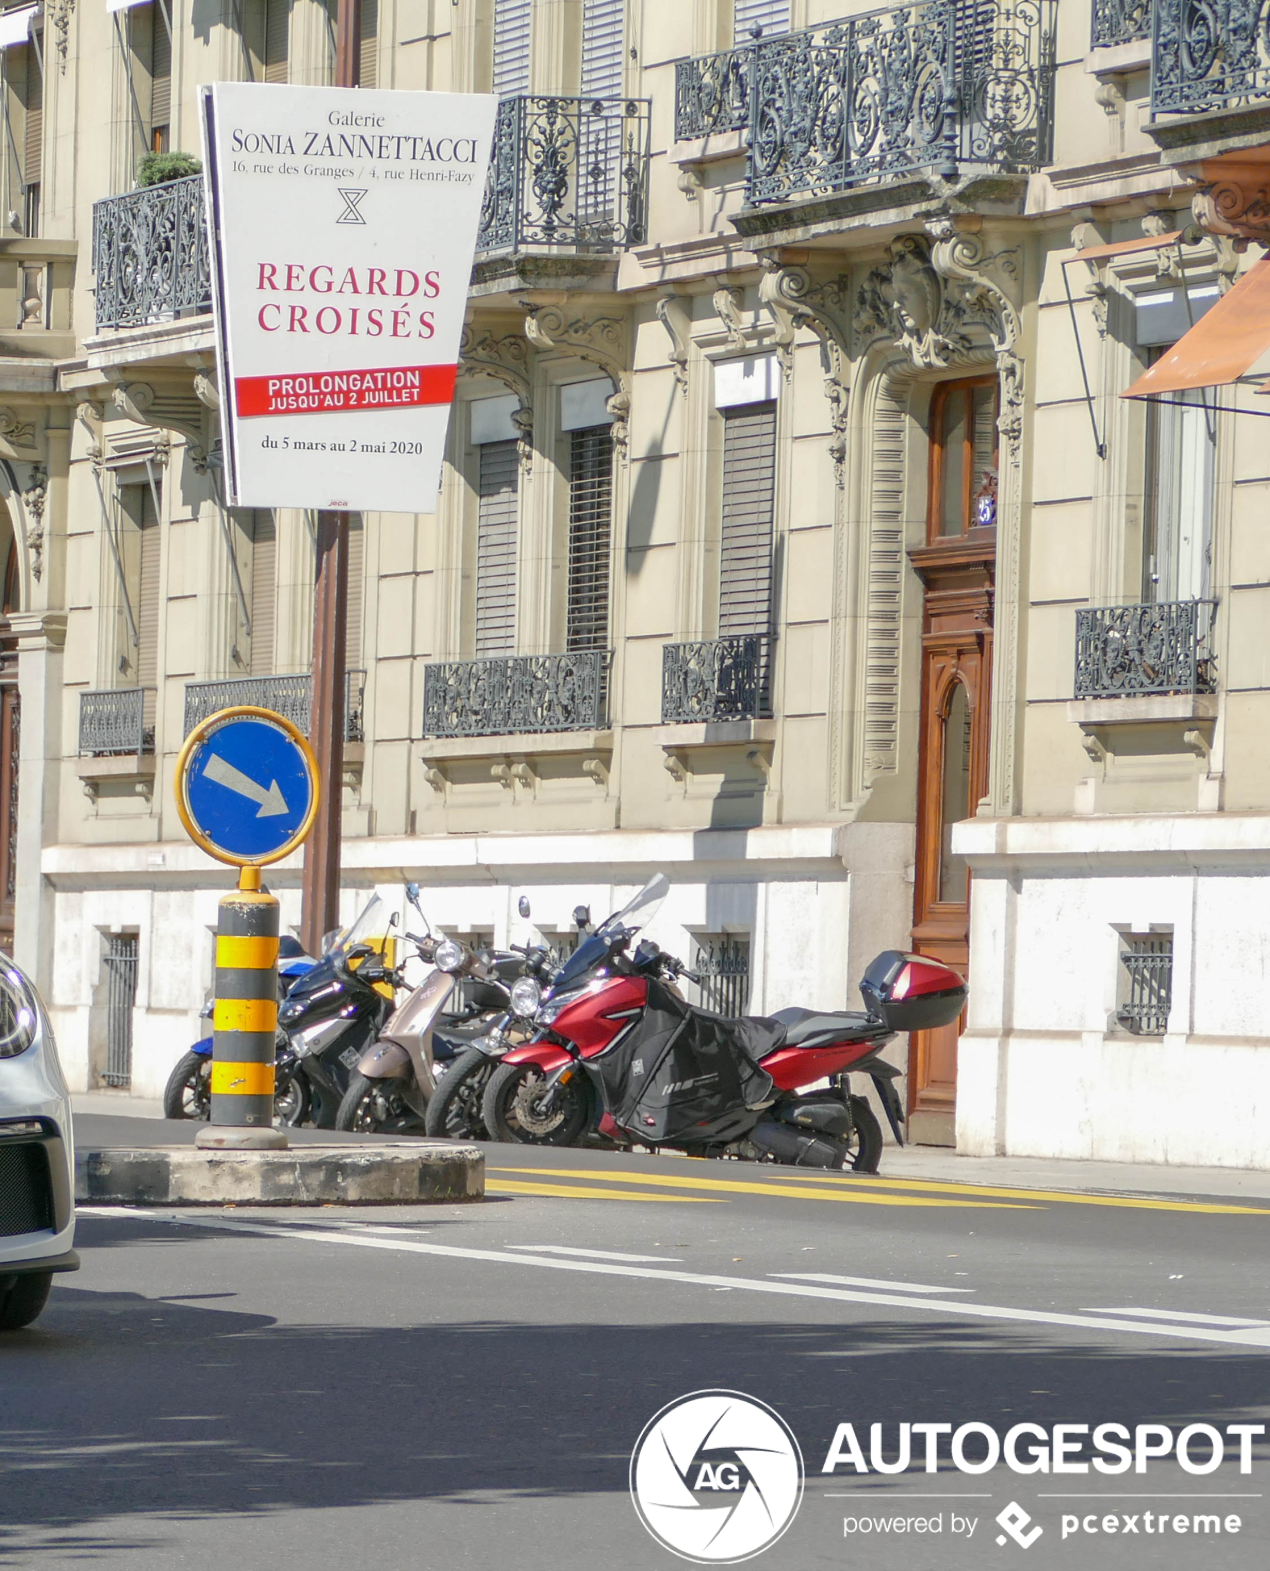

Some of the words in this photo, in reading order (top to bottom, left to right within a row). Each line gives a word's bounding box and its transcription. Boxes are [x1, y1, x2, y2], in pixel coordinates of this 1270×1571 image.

[328, 110, 386, 128] Galerie
[231, 128, 296, 155] SONIA
[303, 131, 479, 164] ZANNETTACCI
[232, 160, 249, 174] 16,
[253, 163, 275, 174] rue
[278, 162, 300, 176] des
[303, 163, 356, 180] Granges
[384, 170, 406, 180] rue
[409, 168, 476, 187] Henri-Fazy
[256, 262, 441, 299] REGARDS
[257, 302, 436, 339] CROISÉS
[267, 369, 421, 397] PROLONGATION
[267, 392, 345, 411] JUSQU'AU
[349, 392, 358, 405] 2
[361, 387, 421, 405] JUILLET
[261, 435, 278, 449] du
[281, 436, 290, 450] 5
[293, 440, 327, 452] mars
[329, 440, 346, 452] au
[349, 439, 357, 453] 2
[360, 440, 386, 454] mai
[389, 440, 423, 455] 2020
[978, 499, 991, 522] 25
